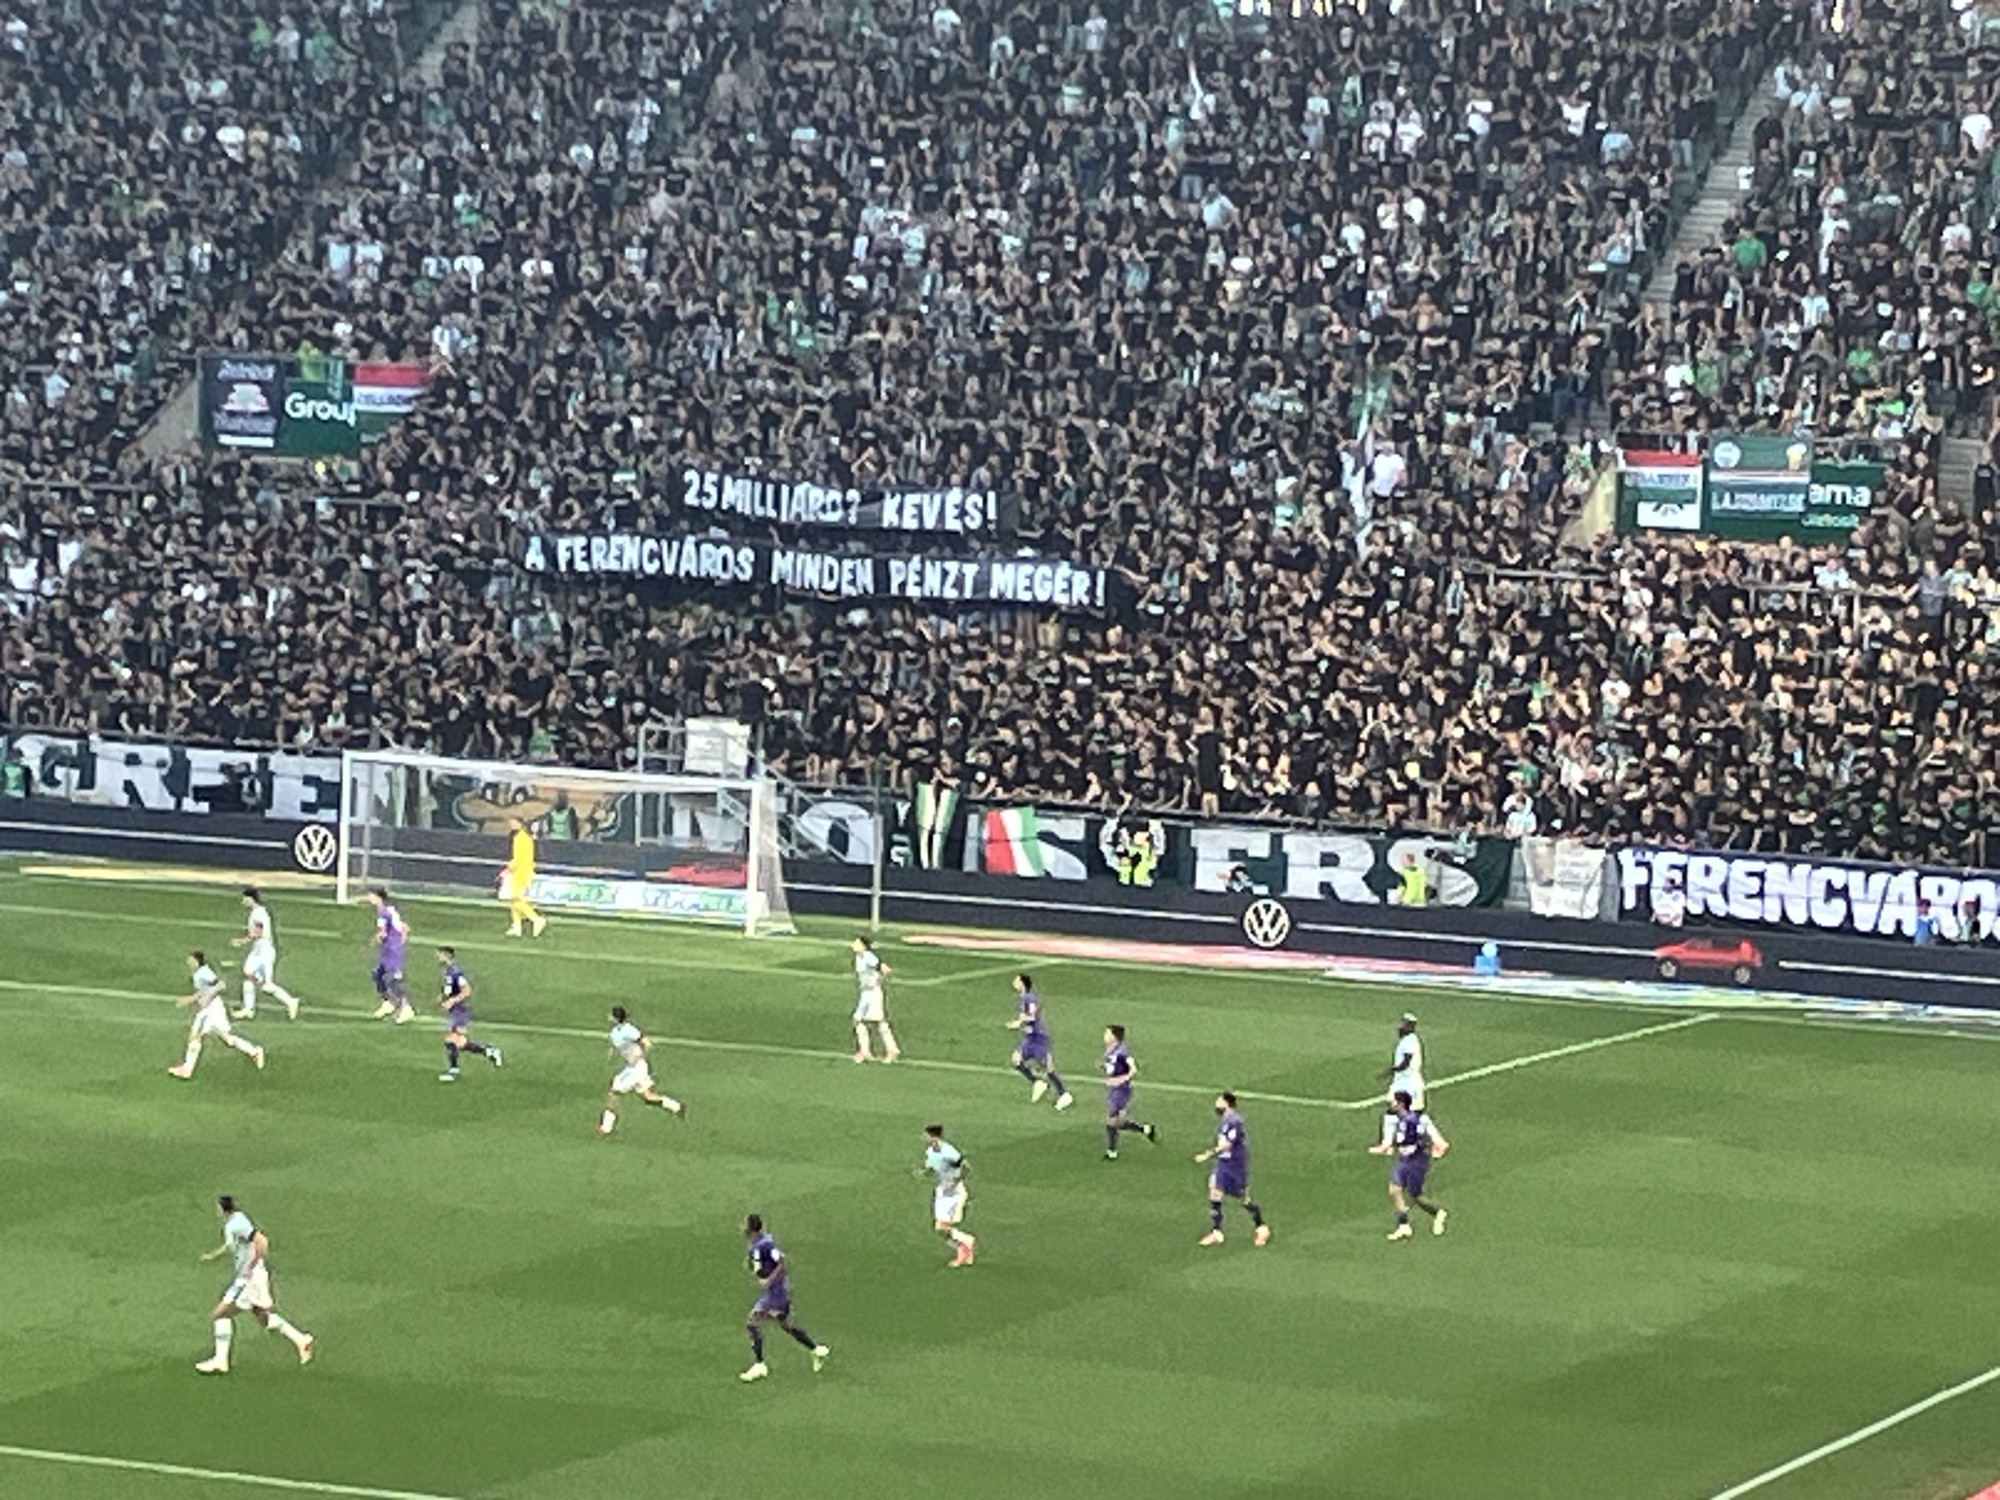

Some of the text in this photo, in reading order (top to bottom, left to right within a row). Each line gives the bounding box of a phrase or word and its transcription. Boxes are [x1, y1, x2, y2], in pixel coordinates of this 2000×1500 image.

[1808, 482, 1872, 507] ama
[525, 536, 546, 573] A
[557, 534, 755, 582] FERENCVÁROS
[771, 549, 875, 598] MINDEN
[889, 554, 980, 600] PÉNZT
[1617, 847, 2000, 940] FERENCVÁRO
